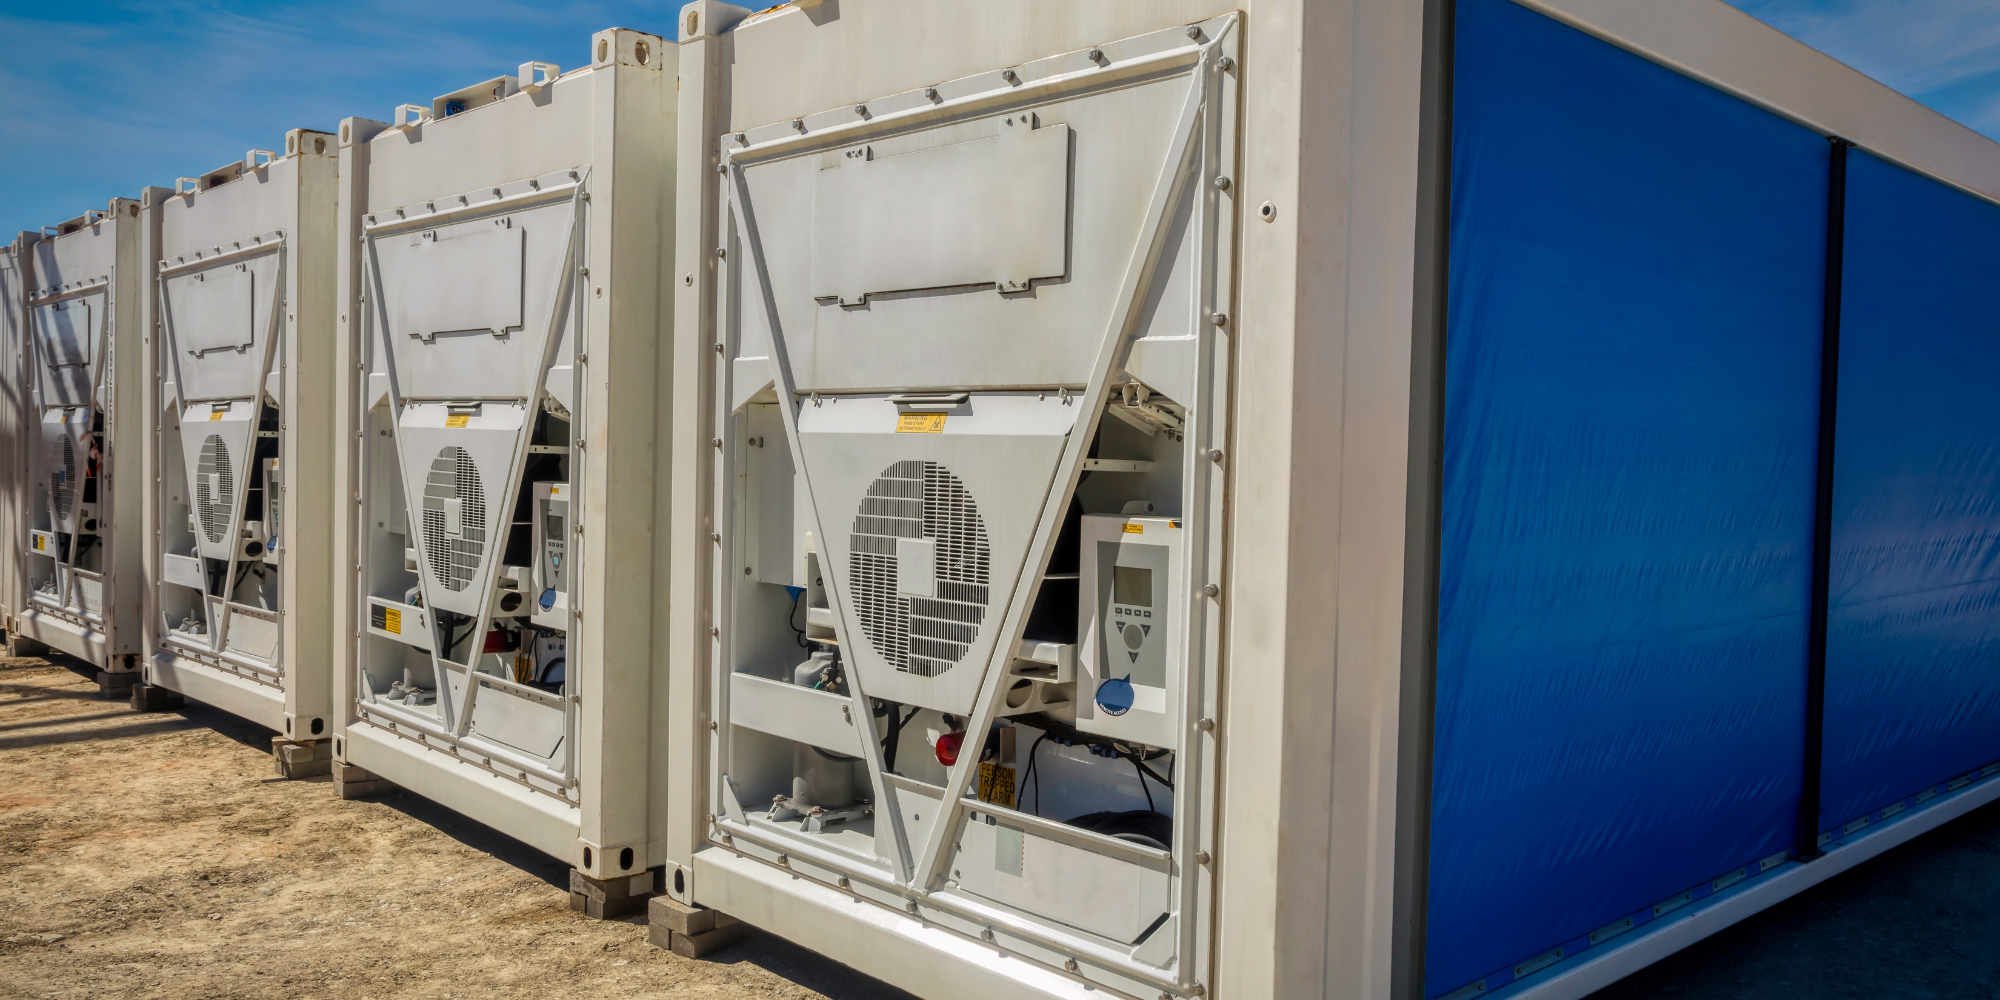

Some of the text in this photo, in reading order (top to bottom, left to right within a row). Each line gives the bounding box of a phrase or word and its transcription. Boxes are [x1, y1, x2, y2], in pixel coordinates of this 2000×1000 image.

[1099, 702, 1127, 716] REMOTE ACCESS
[981, 763, 1014, 781] PERSON
[979, 774, 1015, 794] TRAPPED
